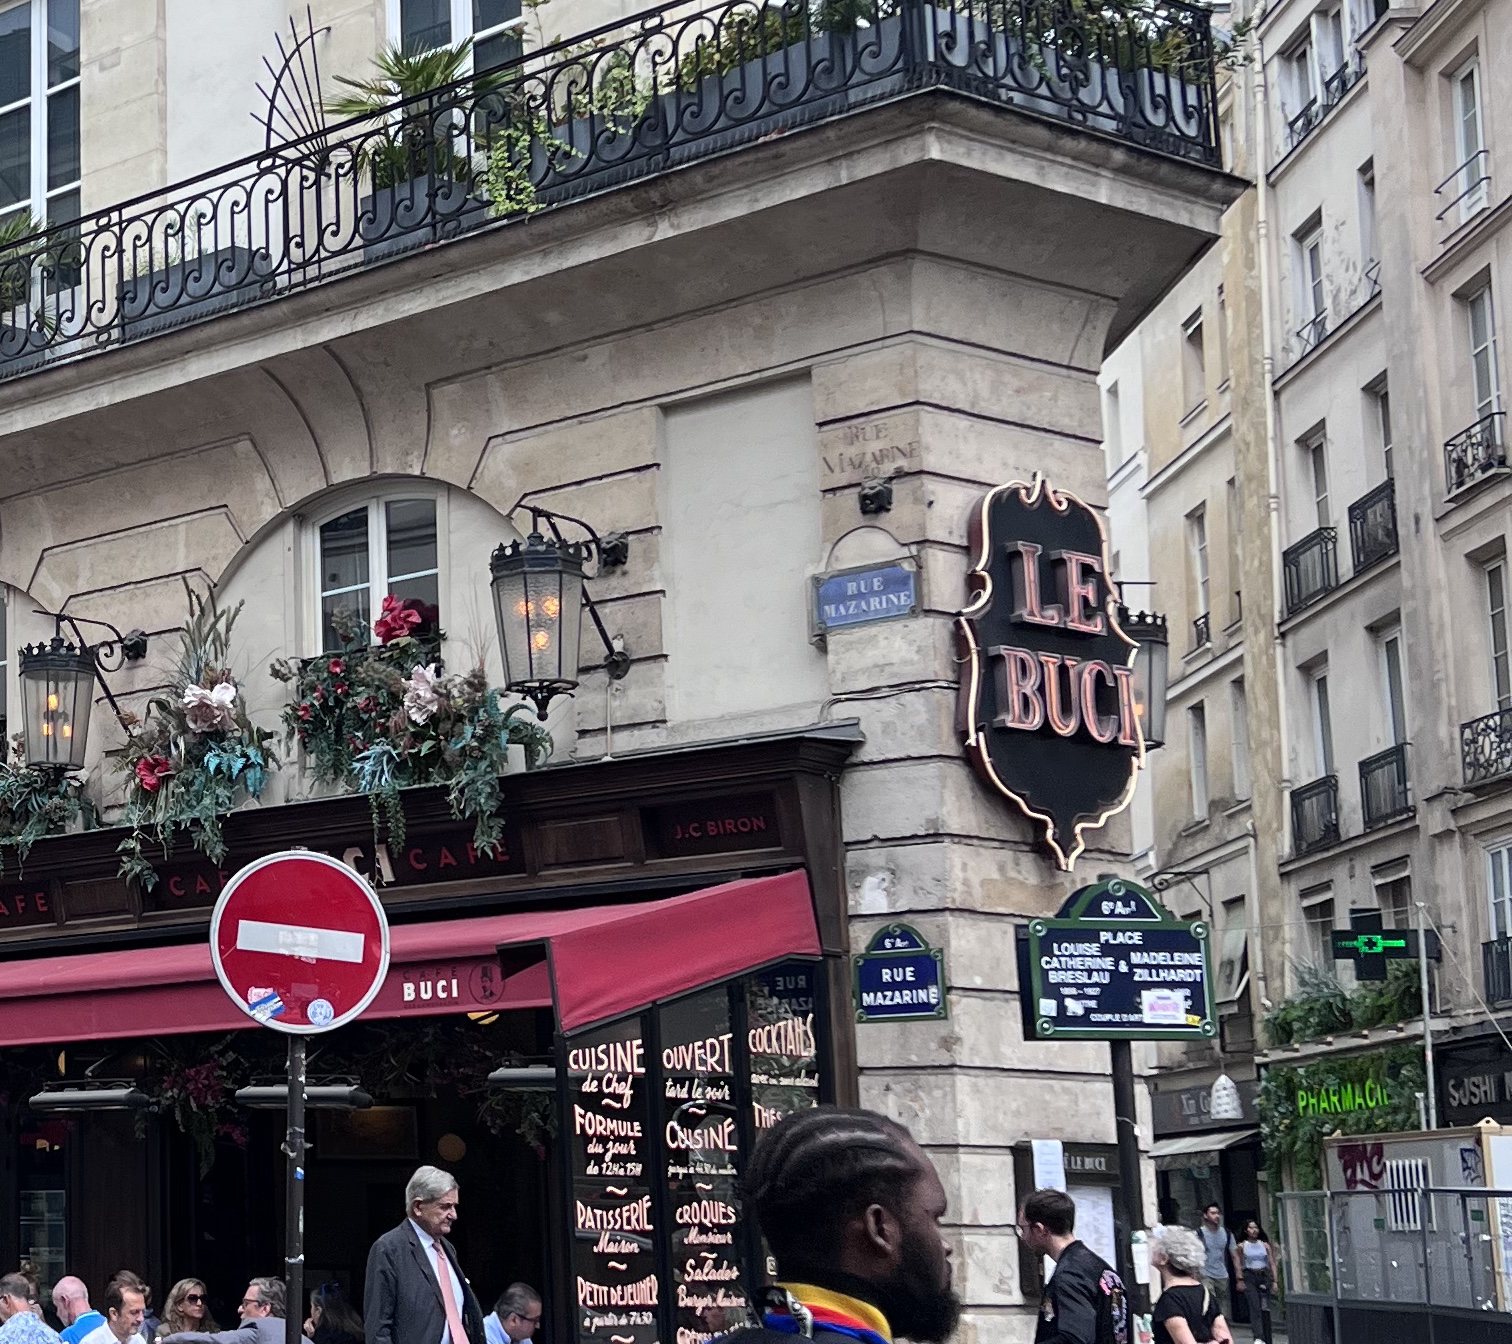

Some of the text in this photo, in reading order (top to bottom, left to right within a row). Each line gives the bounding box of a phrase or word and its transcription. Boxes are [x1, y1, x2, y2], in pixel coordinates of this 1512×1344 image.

[847, 577, 884, 595] RUE
[1005, 540, 1107, 636] LE
[823, 591, 911, 619] MAZARINE
[989, 645, 1138, 746] BUCI
[707, 816, 766, 836] BIRON
[169, 870, 230, 896] CAF
[1053, 943, 1102, 956] LOUISE
[1099, 931, 1143, 945] PLACE
[1040, 956, 1116, 970] CATHERINE
[1130, 951, 1203, 965] MADELEINE
[881, 966, 916, 983] RUE
[1048, 970, 1111, 984] BRESLAU
[1133, 968, 1203, 982] ZILLHARDT
[403, 979, 458, 1001] BUCI
[862, 986, 938, 1007] MAZARINE
[748, 1013, 816, 1057] COCKTAILS
[569, 1039, 646, 1073] CUISINE
[662, 1033, 733, 1073] OUVERT
[582, 1072, 634, 1109] de Chef
[665, 1078, 690, 1099] tard
[1448, 1075, 1495, 1106] SUSHI
[573, 1104, 643, 1137] FORMULE
[666, 1117, 738, 1151] CUISINE
[587, 1136, 637, 1162] du jour
[576, 1194, 654, 1231] PATISSERIE
[676, 1200, 737, 1228] CROQUES
[593, 1231, 640, 1254] Maison
[684, 1258, 741, 1282] Salades
[577, 1276, 609, 1307] PETIT
